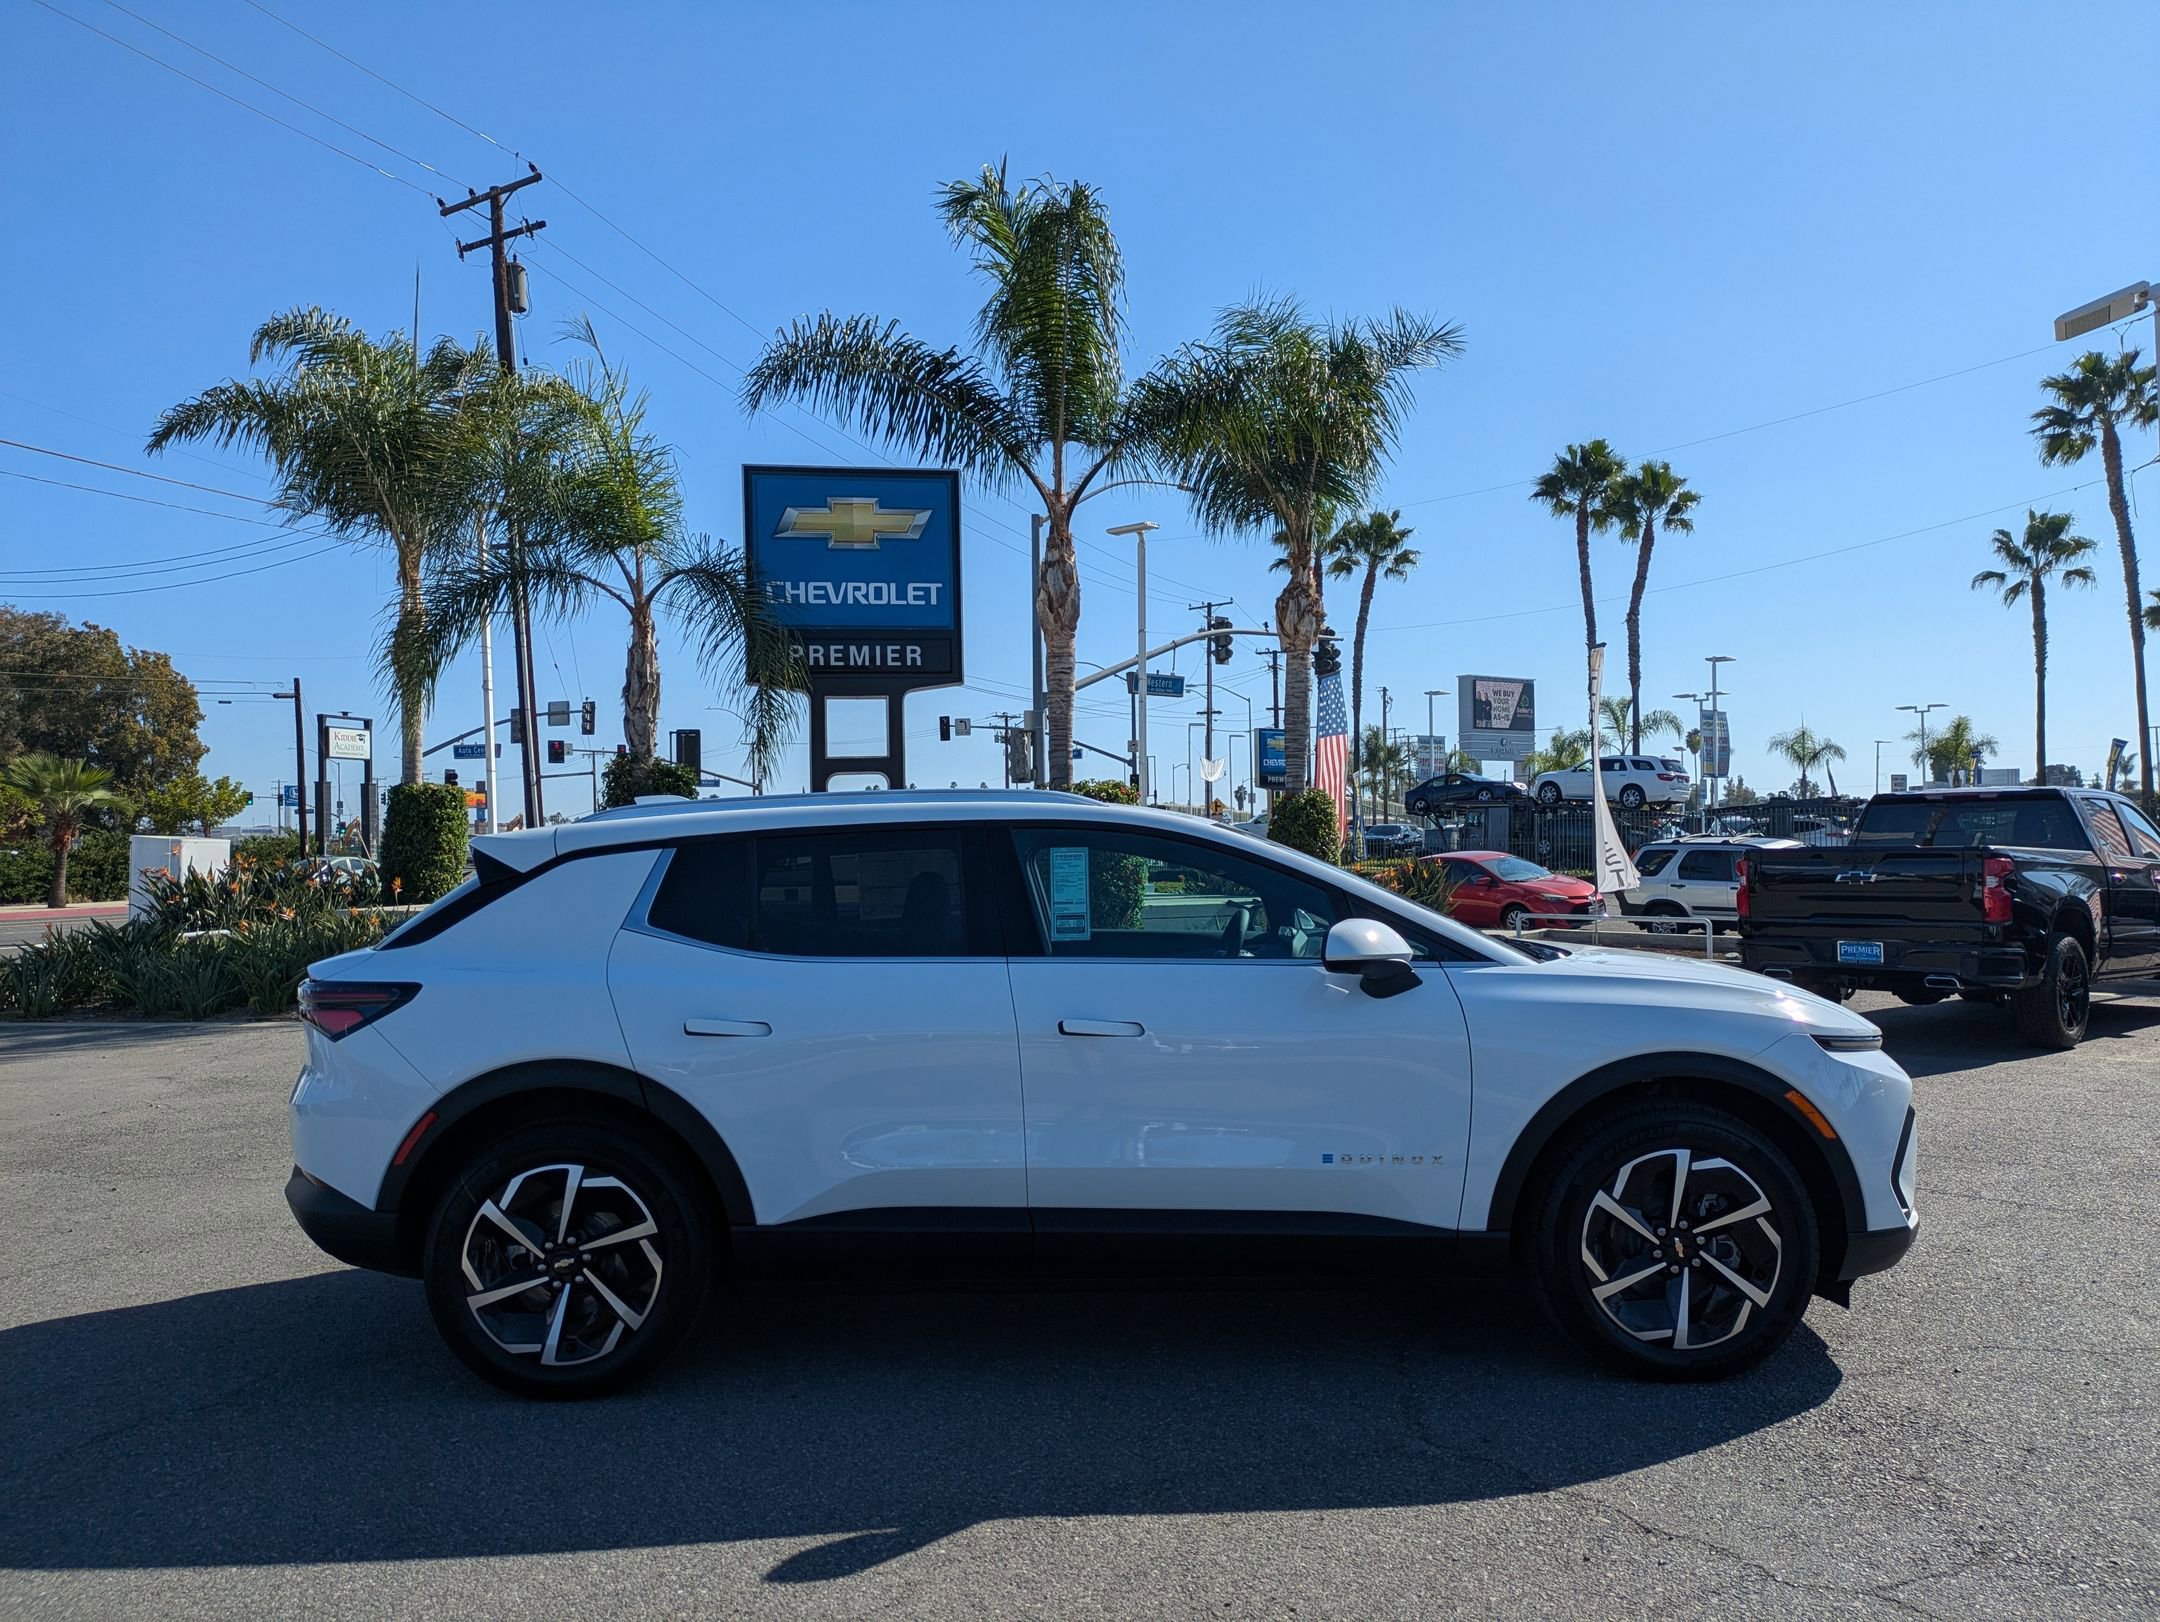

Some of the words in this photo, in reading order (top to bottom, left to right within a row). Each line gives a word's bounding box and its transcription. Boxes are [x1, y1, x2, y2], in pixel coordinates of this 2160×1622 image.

[766, 581, 943, 606] CHEVROLET
[788, 645, 922, 667] PREMIER
[1492, 689, 1503, 697] WE
[1503, 690, 1515, 698] BUY
[333, 731, 358, 742] KIDDIE
[1841, 945, 1881, 956] PREMIER
